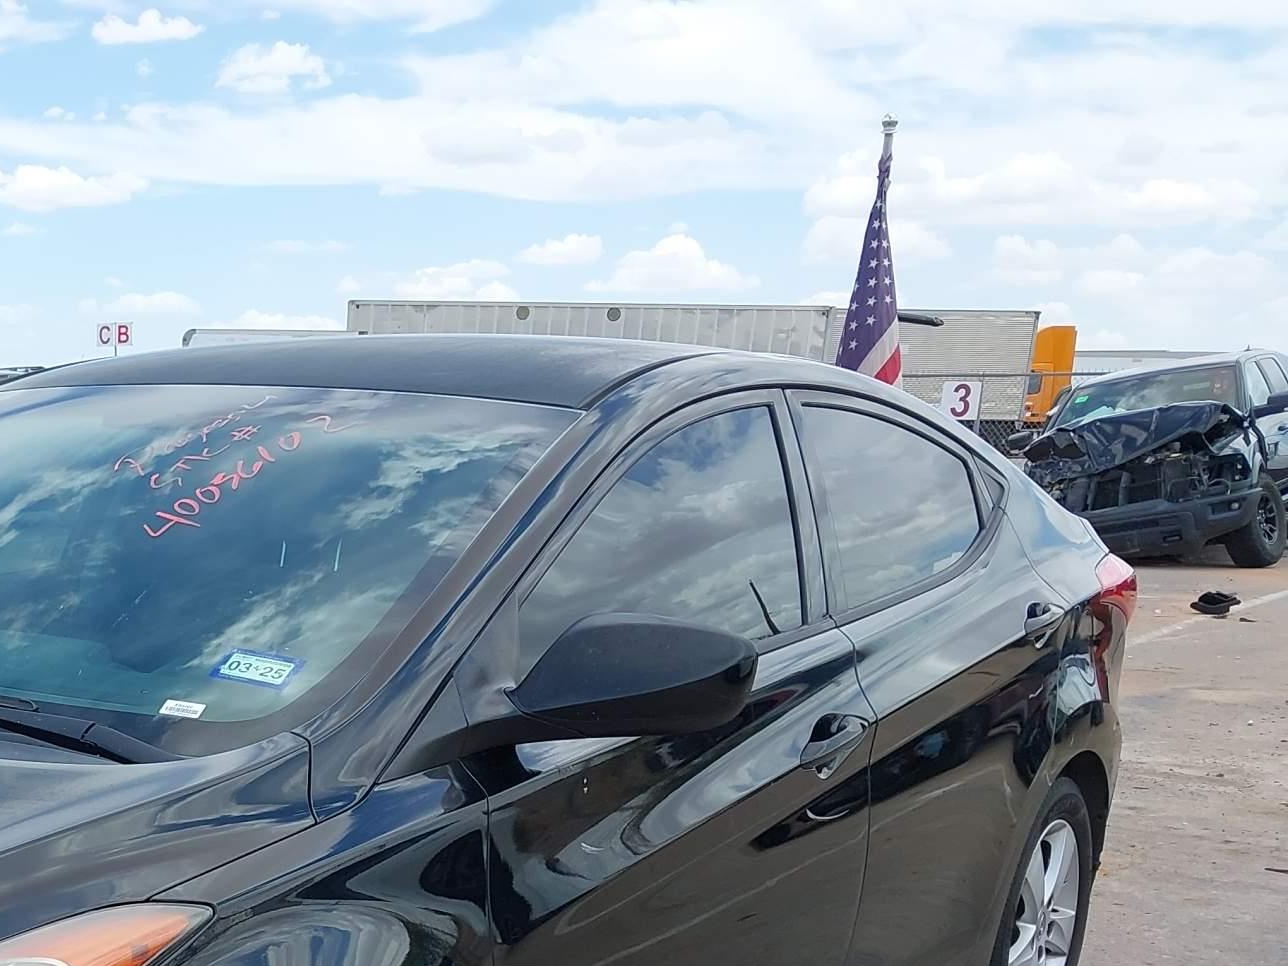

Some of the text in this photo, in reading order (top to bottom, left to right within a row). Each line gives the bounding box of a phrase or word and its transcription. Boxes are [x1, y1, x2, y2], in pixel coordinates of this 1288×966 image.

[99, 325, 130, 345] C B
[950, 383, 972, 417] 3
